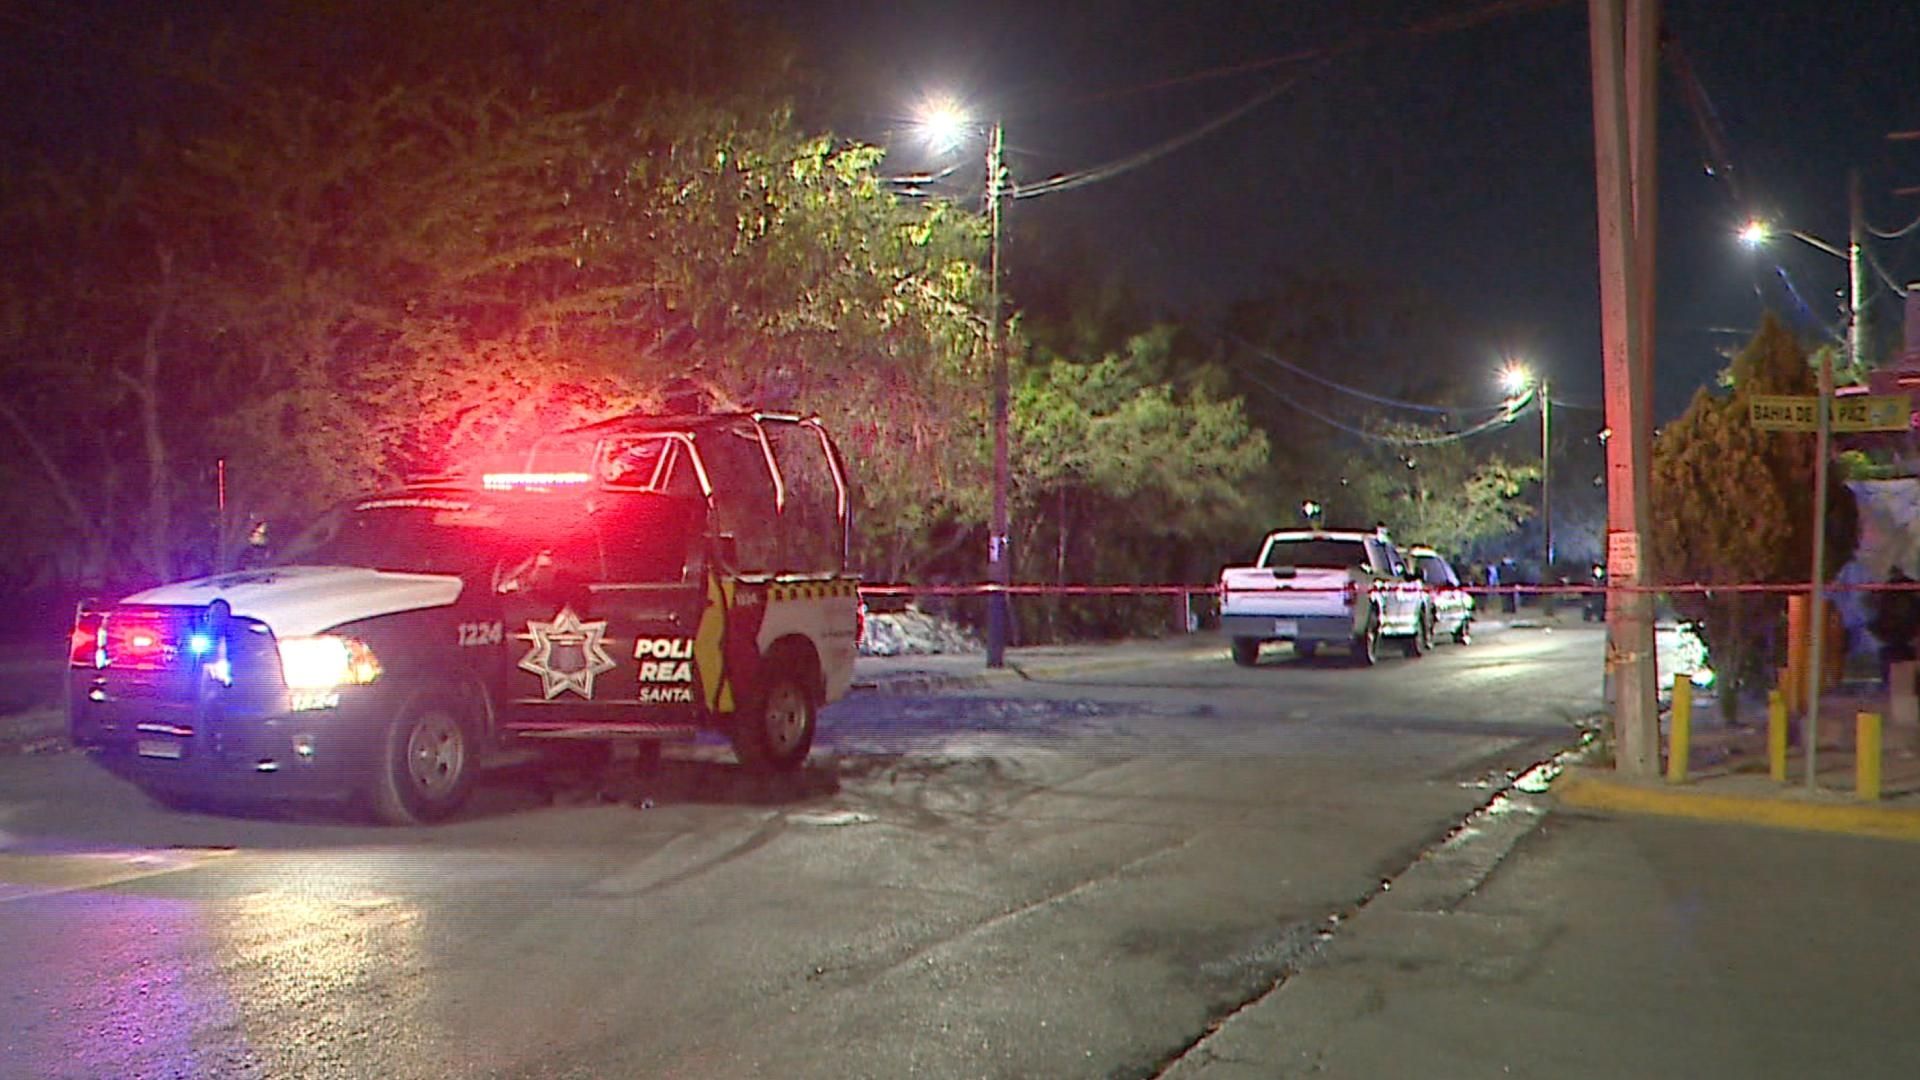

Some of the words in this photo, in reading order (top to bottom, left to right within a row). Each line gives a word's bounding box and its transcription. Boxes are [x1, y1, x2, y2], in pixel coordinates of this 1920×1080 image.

[1753, 404, 1792, 422] BAHIA
[1796, 405, 1812, 423] DE
[1838, 405, 1867, 423] PAZ
[458, 622, 502, 646] 1224
[634, 638, 693, 659] POLI
[639, 661, 692, 682] REA
[639, 687, 692, 703] SANTA
